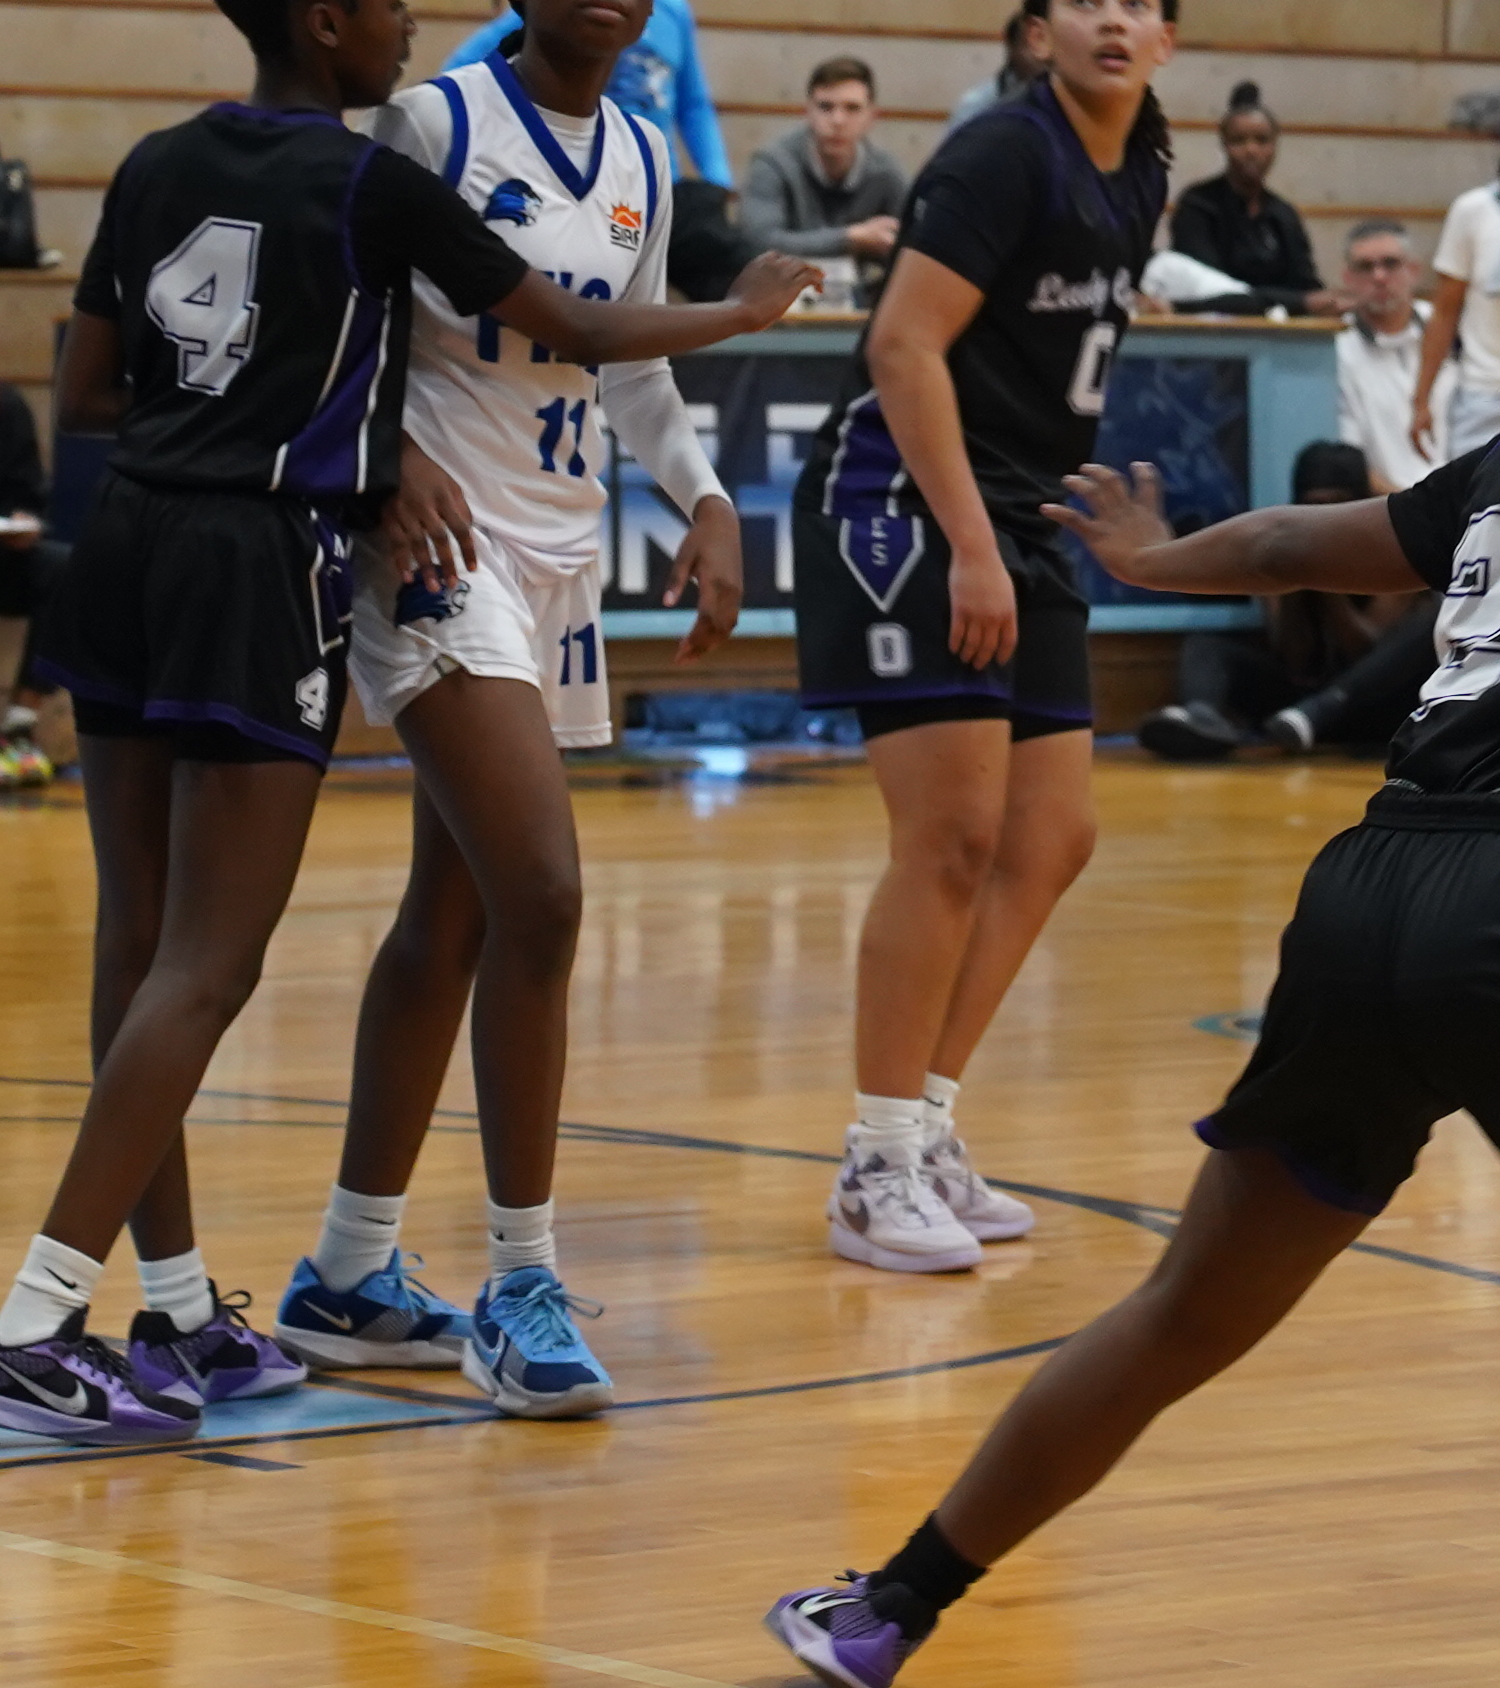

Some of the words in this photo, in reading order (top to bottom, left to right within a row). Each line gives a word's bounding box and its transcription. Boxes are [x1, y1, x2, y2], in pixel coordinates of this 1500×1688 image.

[145, 215, 263, 397] 4
[536, 396, 587, 478] 11
[559, 622, 598, 686] 11
[867, 622, 913, 678] 0
[295, 666, 329, 732] 4
